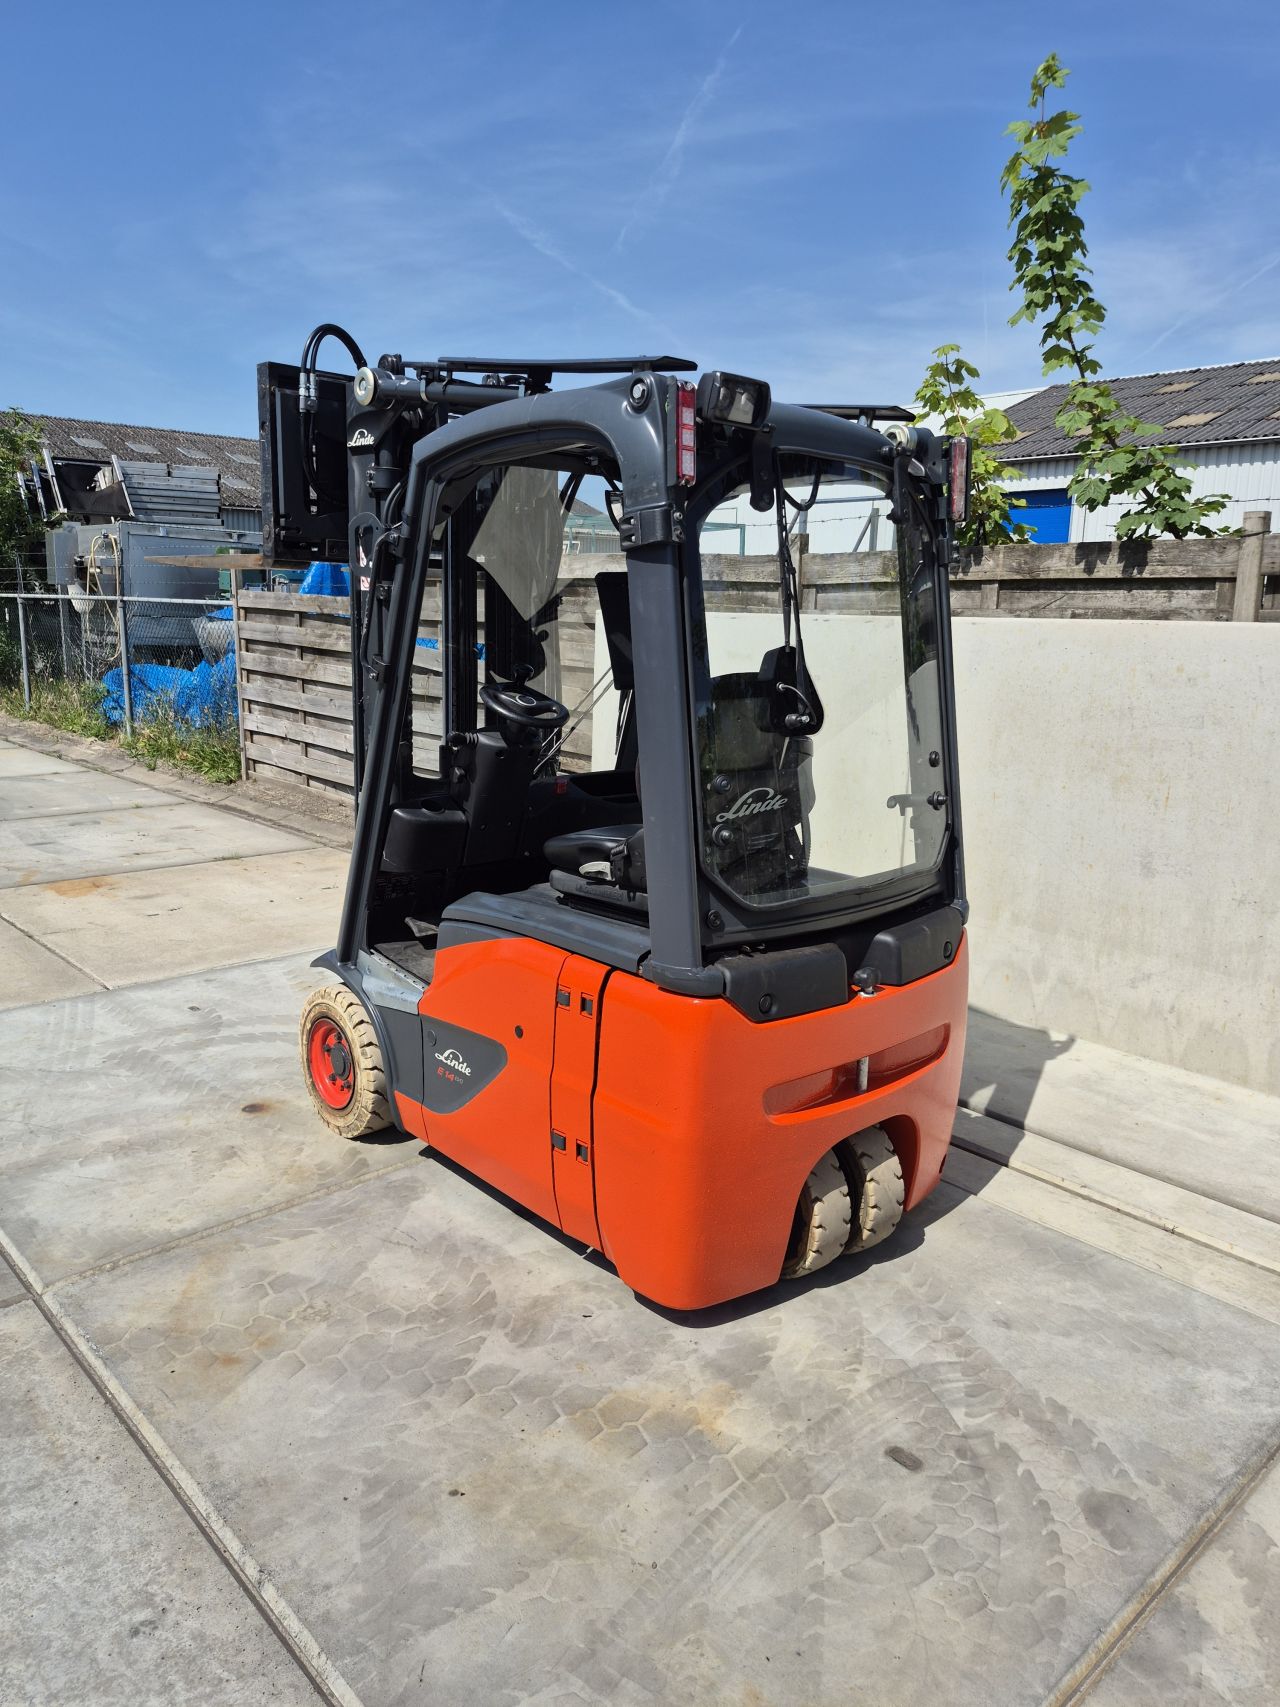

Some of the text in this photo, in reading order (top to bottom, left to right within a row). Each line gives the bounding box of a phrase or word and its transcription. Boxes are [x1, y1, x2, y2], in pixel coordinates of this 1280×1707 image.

[346, 428, 375, 448] Linde
[716, 787, 788, 822] Linde
[435, 1049, 472, 1076] Linde
